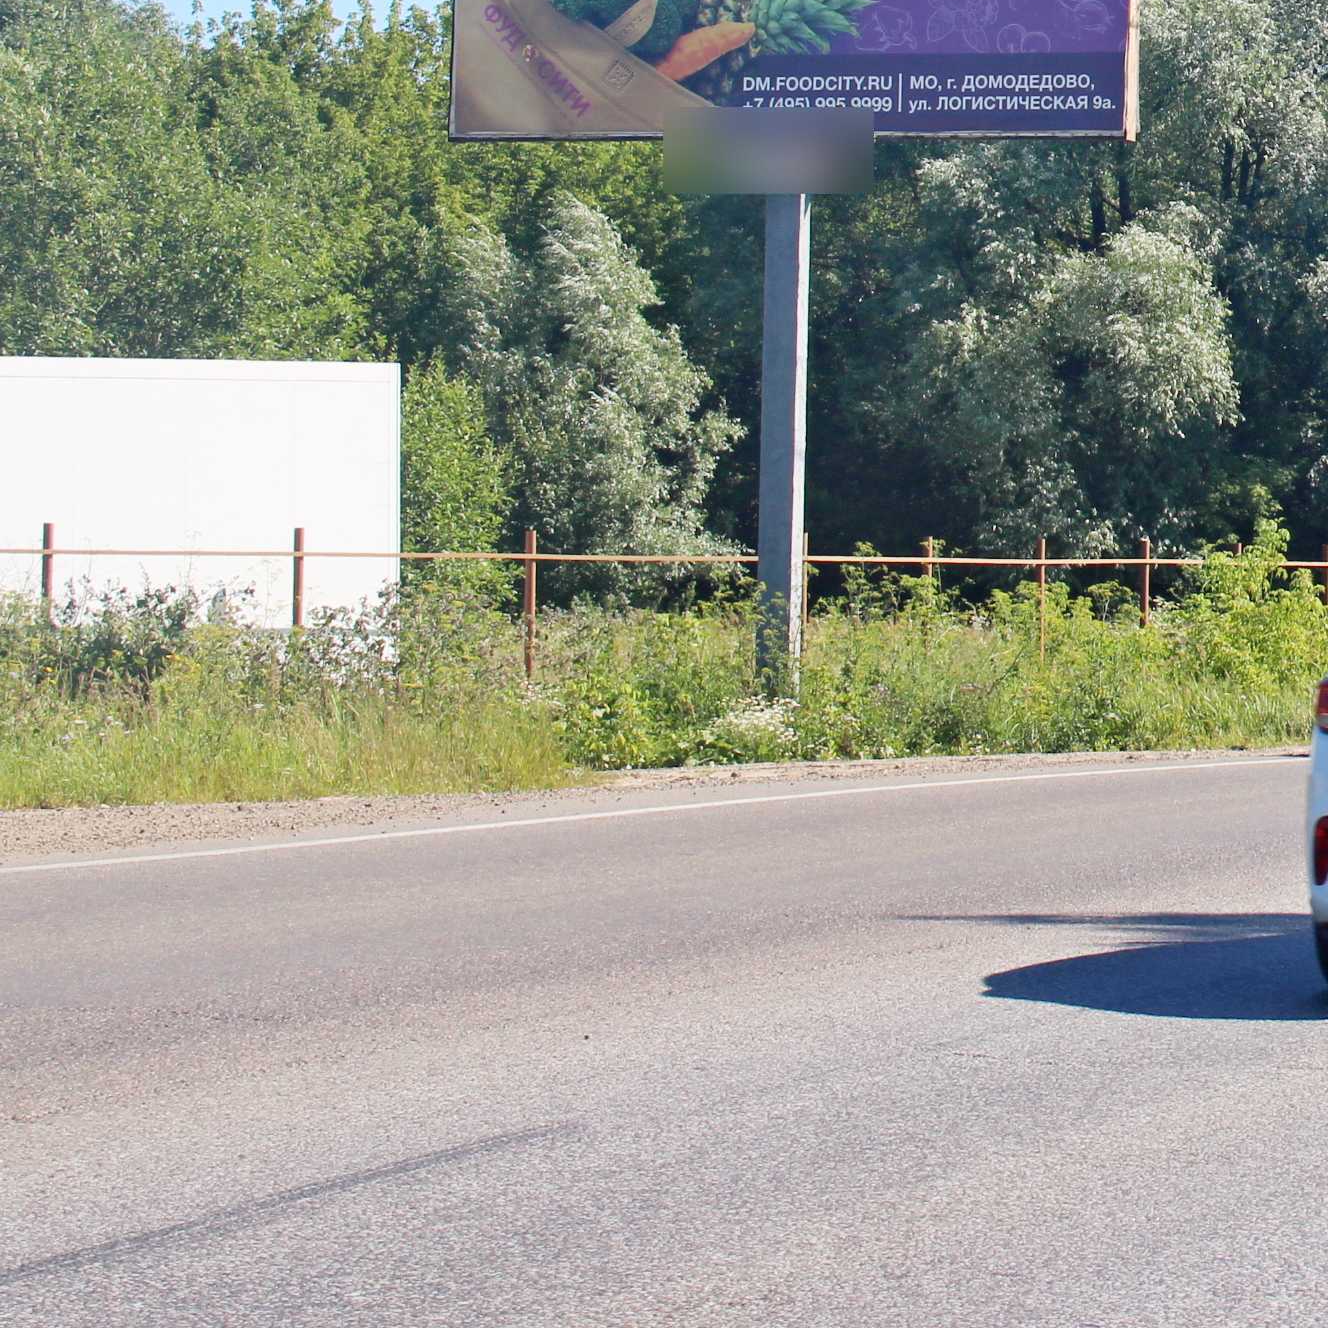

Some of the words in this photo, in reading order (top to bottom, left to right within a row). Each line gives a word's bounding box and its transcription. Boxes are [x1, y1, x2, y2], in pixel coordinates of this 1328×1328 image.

[743, 76, 893, 91] DM.FOODCITY.RU
[910, 75, 942, 92] МО,
[947, 78, 957, 89] г.
[961, 74, 1095, 92] ДОМОДЕДОВО,
[909, 99, 932, 113] ул.
[936, 96, 1088, 110] ЛОГИСТИЧЕСКАЯ
[1093, 96, 1116, 109] 9а.
